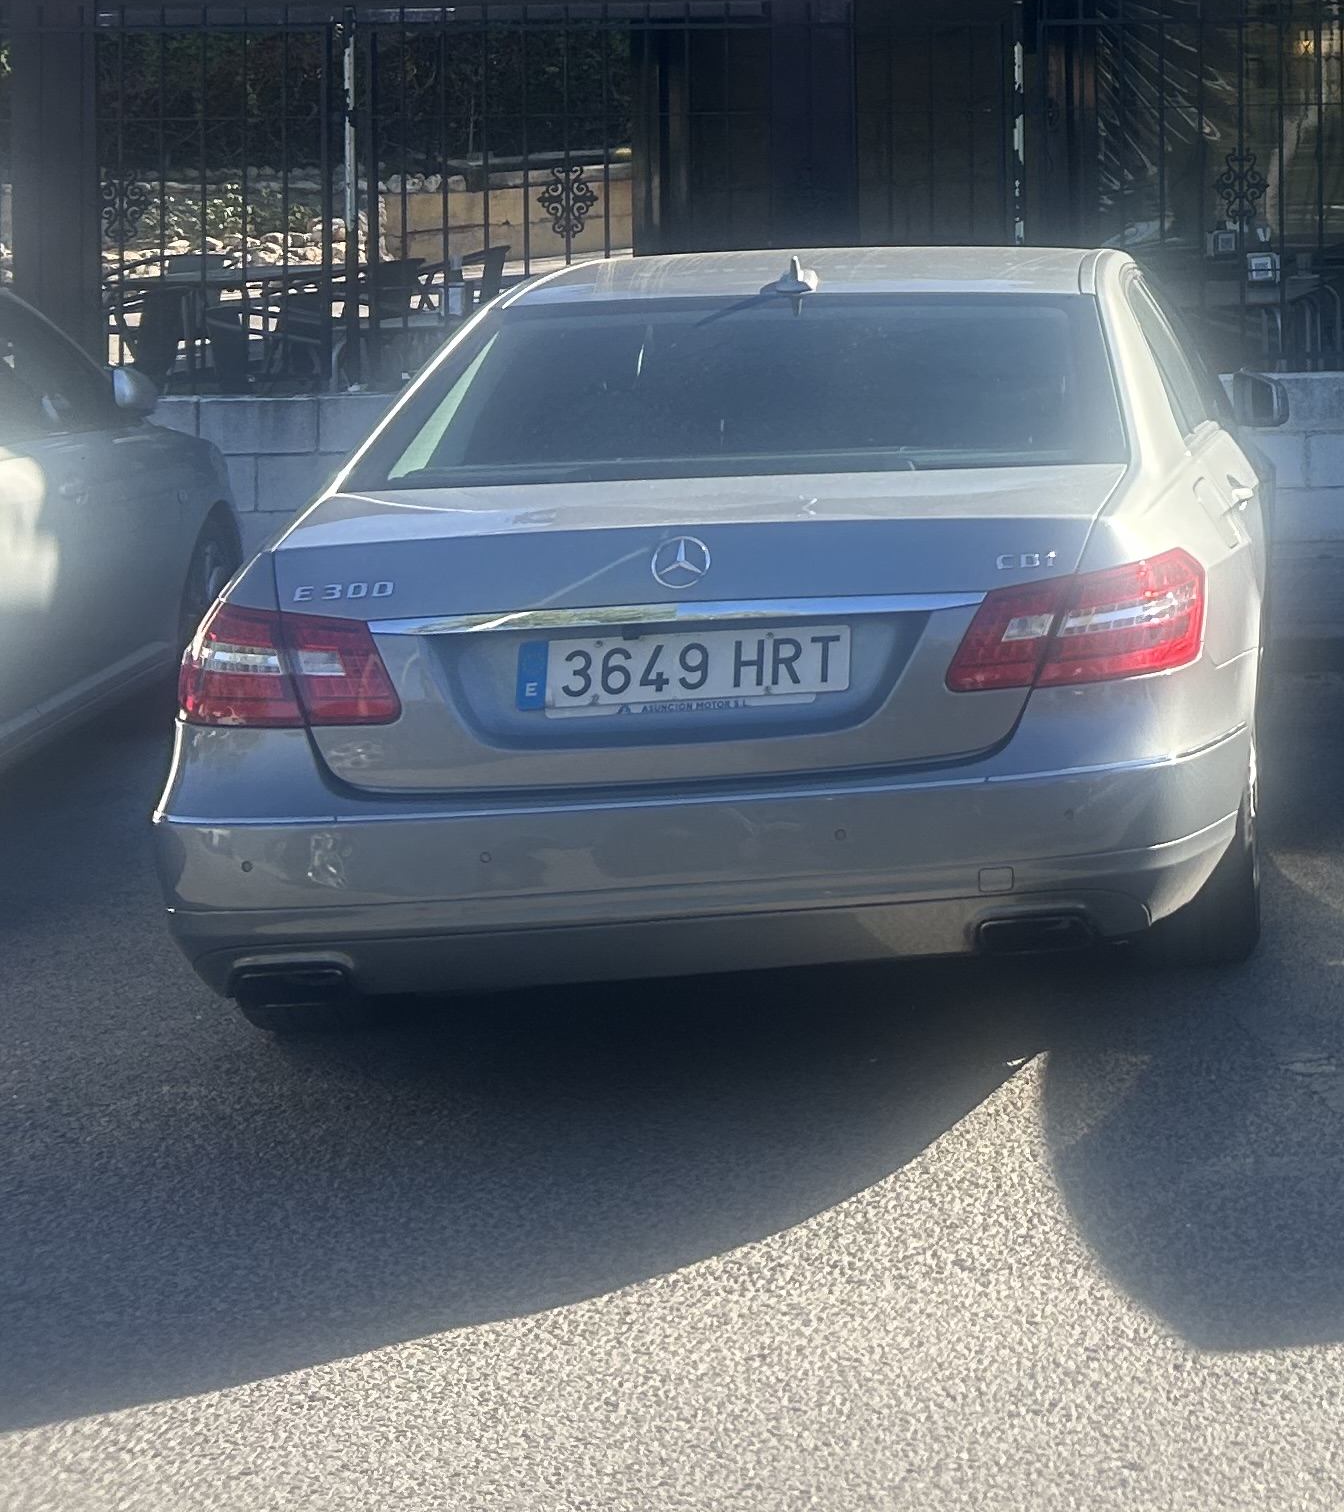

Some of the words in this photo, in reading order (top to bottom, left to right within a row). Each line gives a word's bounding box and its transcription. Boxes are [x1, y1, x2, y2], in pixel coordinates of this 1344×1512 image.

[293, 585, 315, 602] E
[321, 581, 394, 601] 300
[525, 682, 539, 697] E
[561, 642, 710, 698] 3649
[733, 634, 841, 688] HRT
